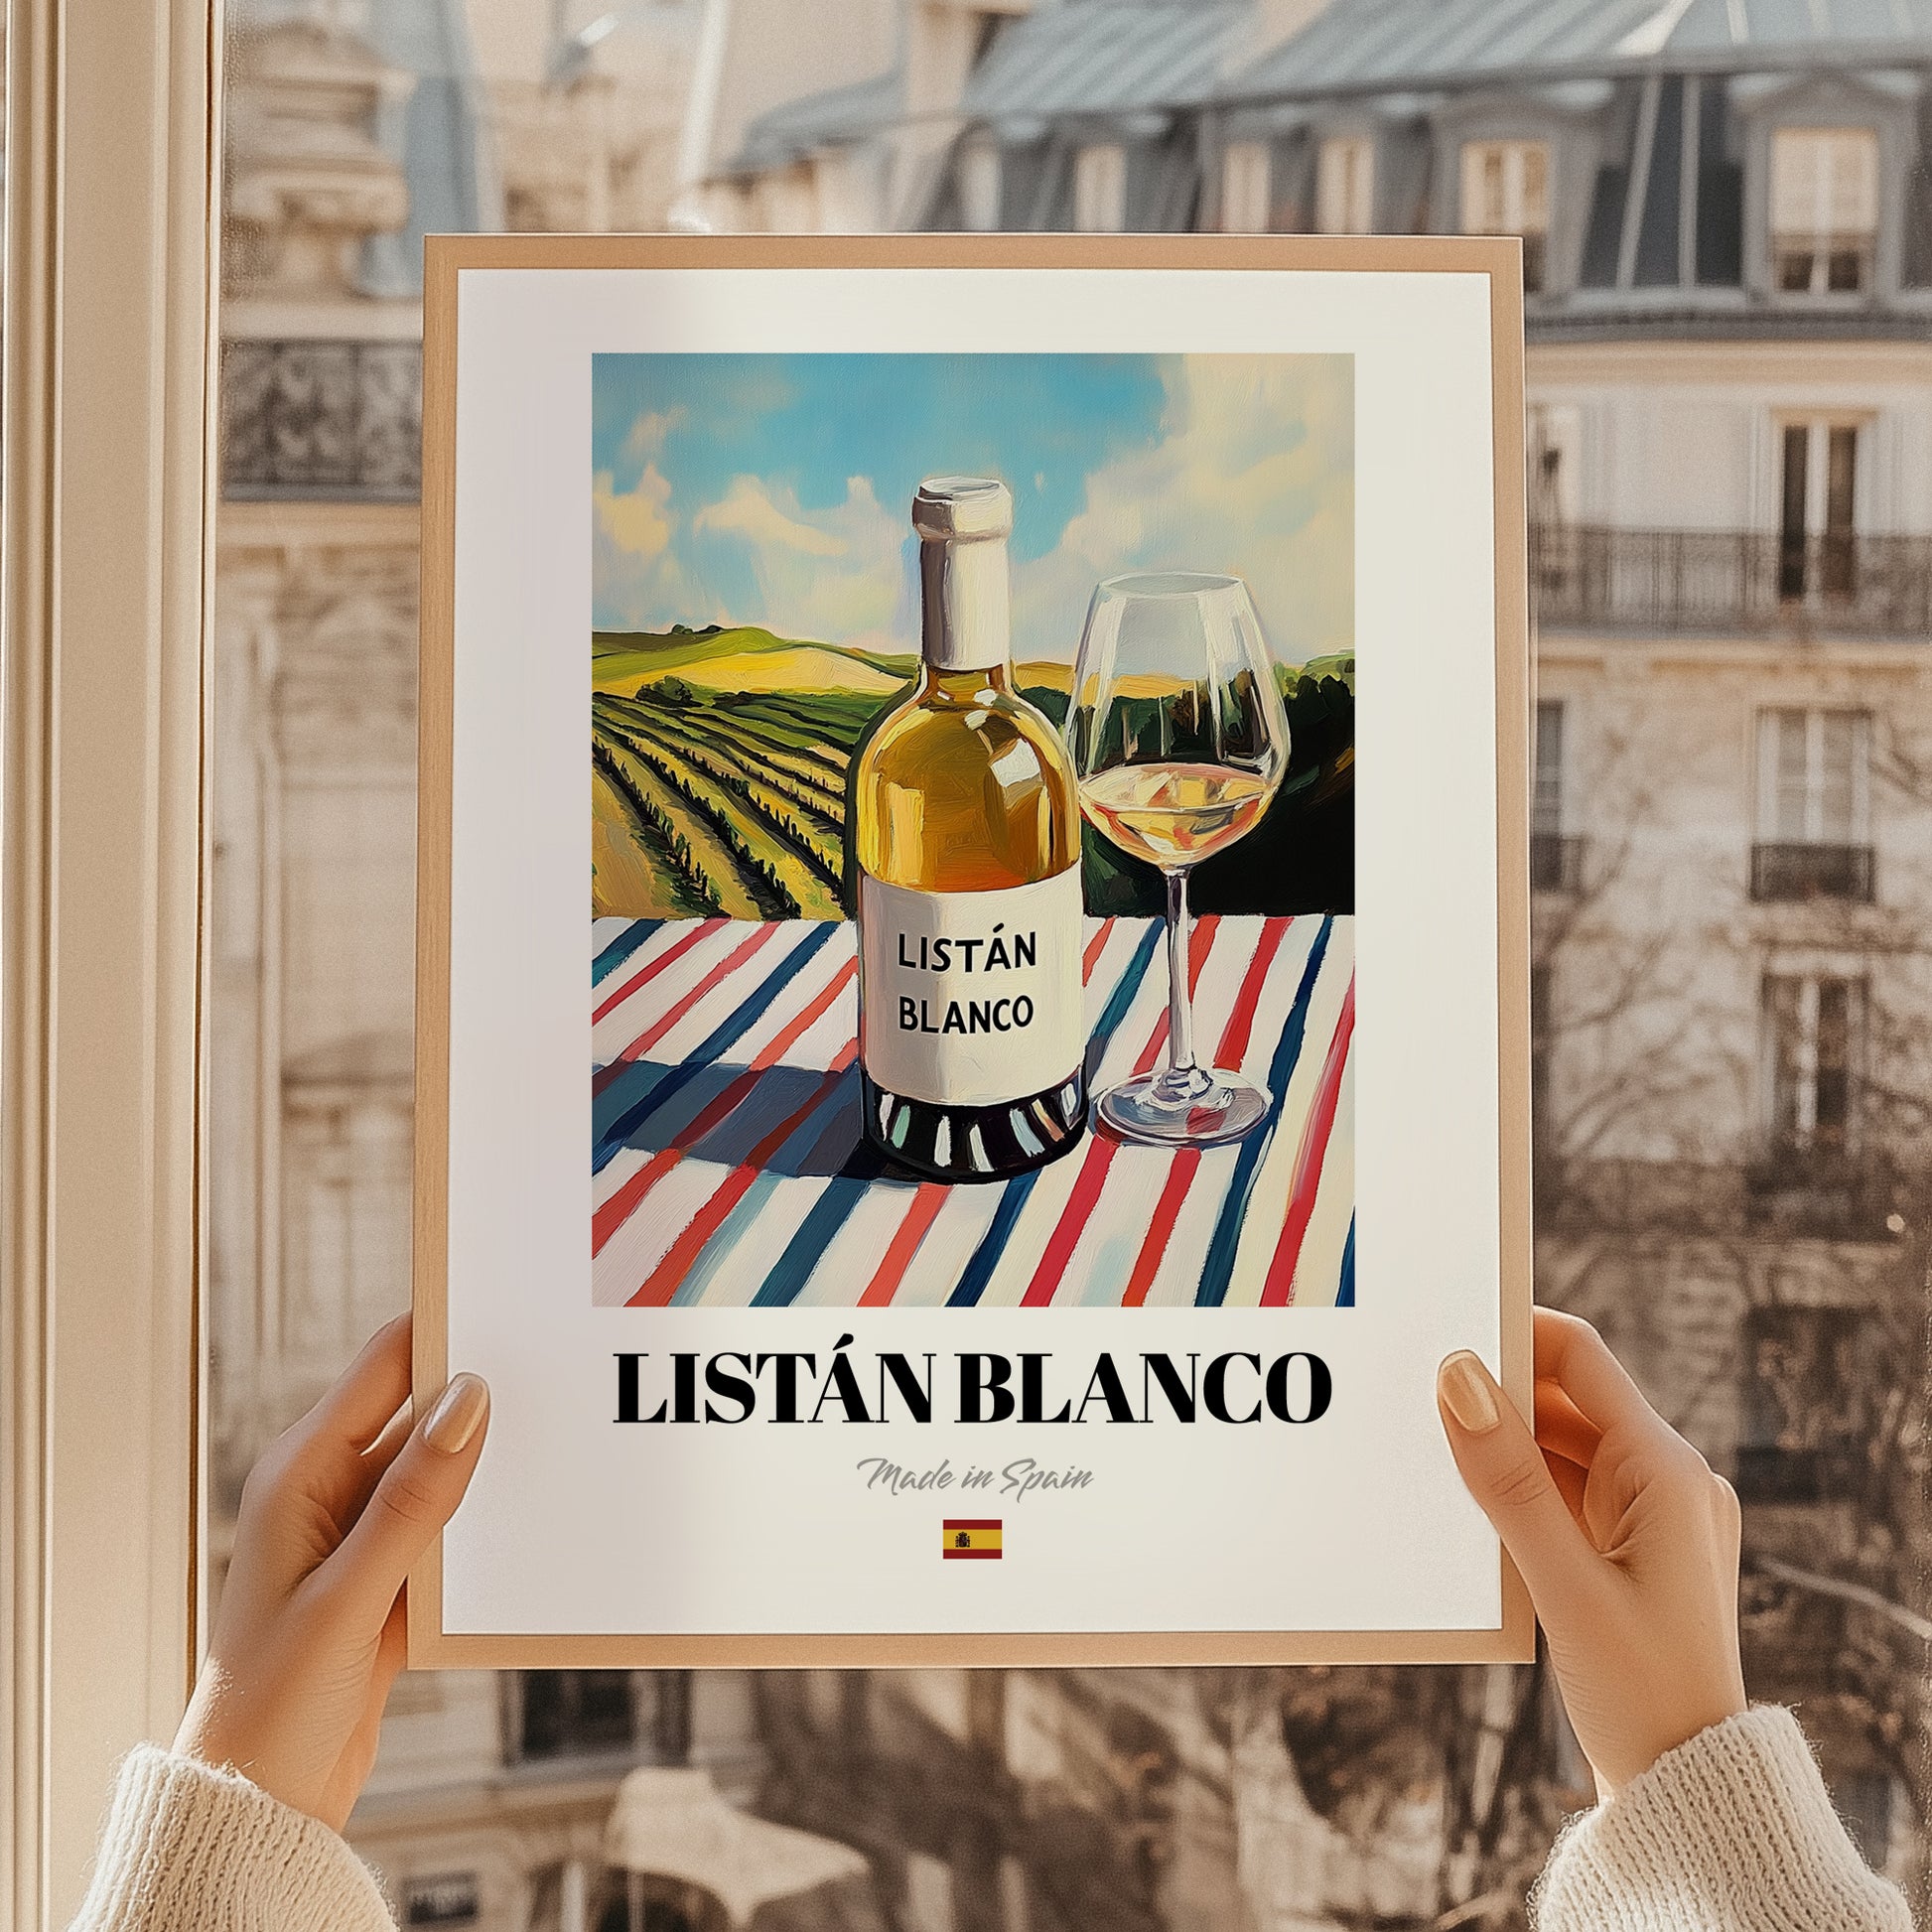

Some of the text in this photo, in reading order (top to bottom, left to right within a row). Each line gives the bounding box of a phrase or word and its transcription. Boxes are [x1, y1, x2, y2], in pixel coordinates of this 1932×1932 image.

[897, 922, 1036, 973] LISTÁN
[898, 995, 1035, 1035] BLANCO
[612, 1332, 1332, 1425] LISTÁN BLANCO
[856, 1457, 1095, 1504] Made in Spain
